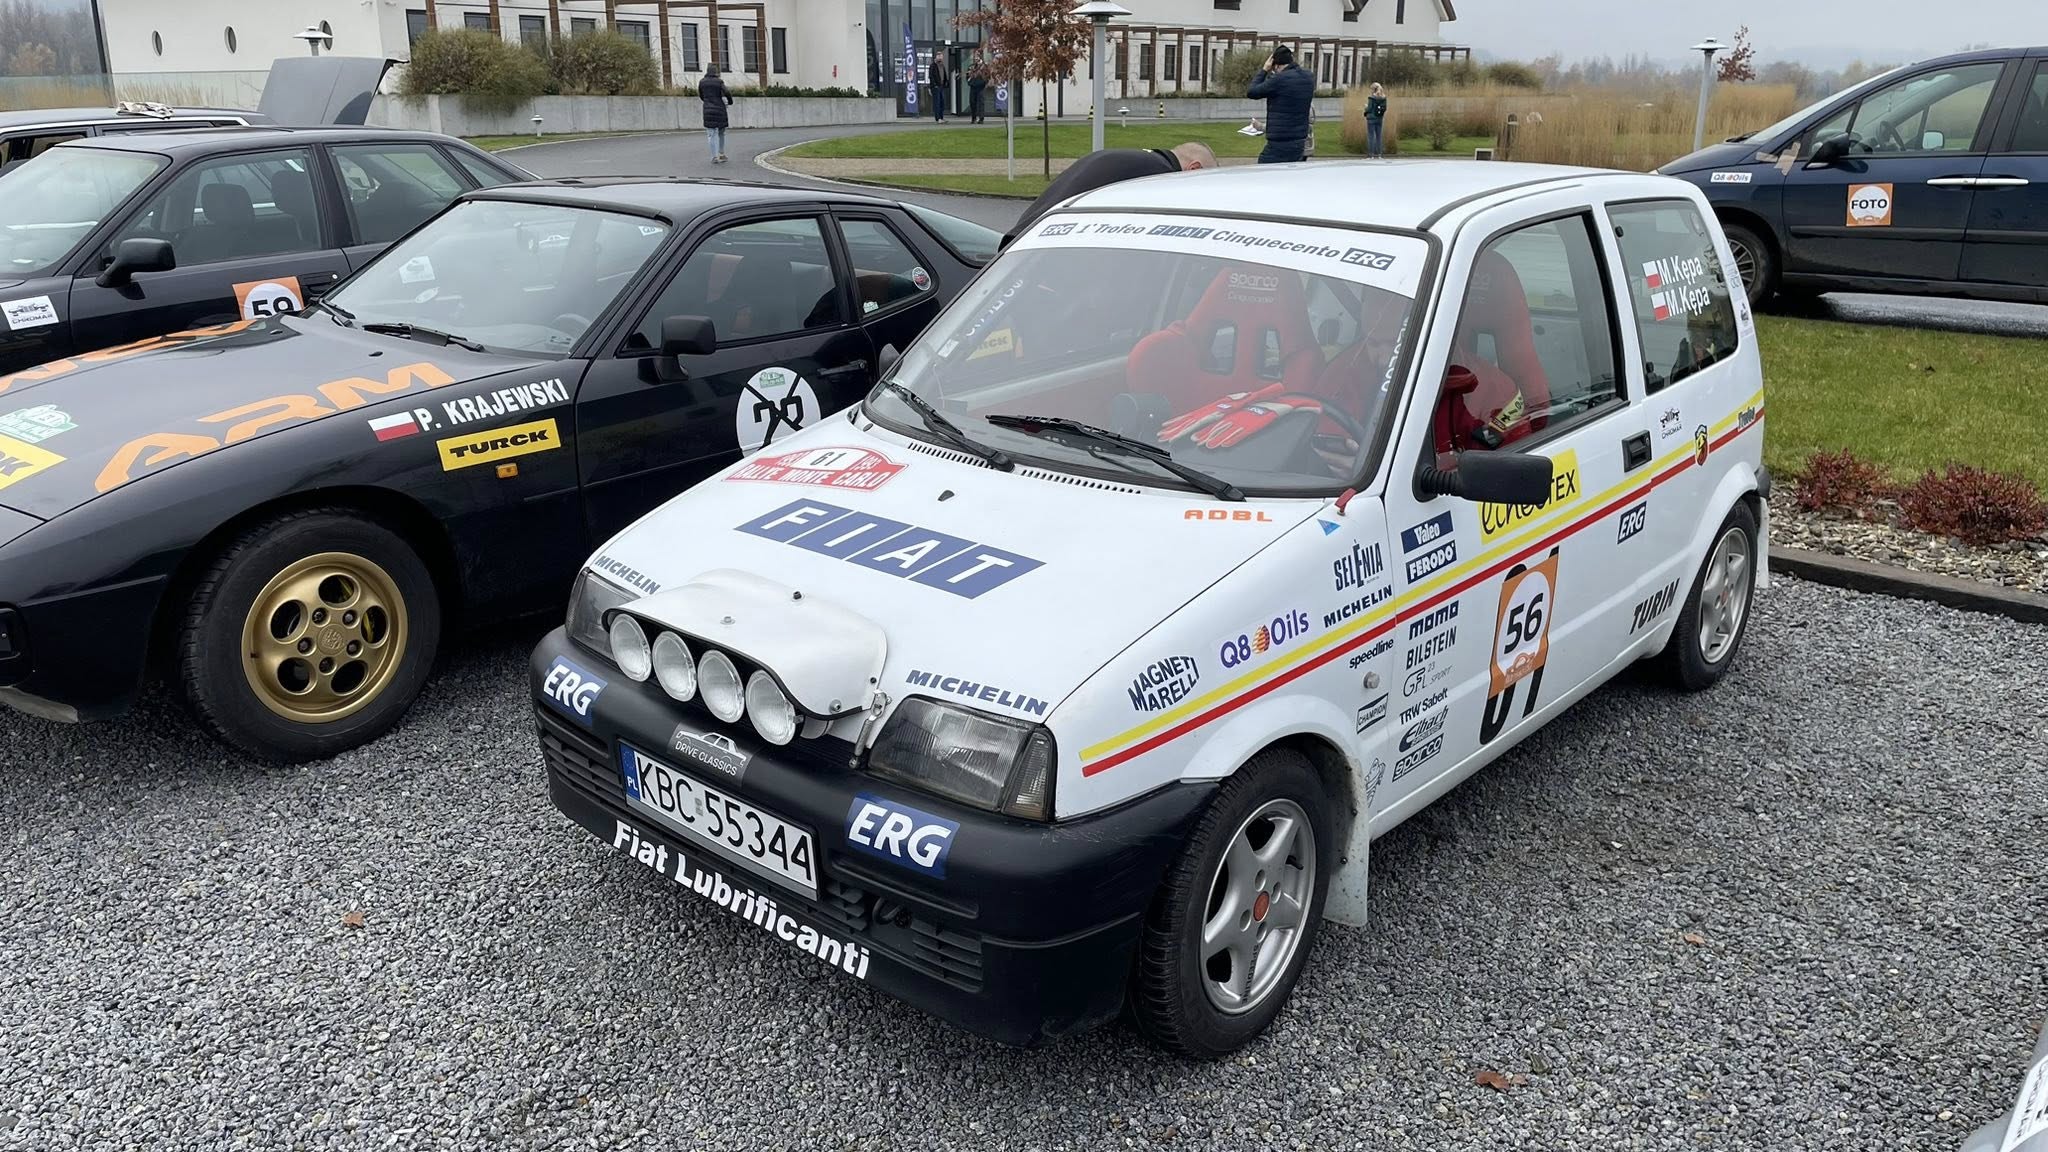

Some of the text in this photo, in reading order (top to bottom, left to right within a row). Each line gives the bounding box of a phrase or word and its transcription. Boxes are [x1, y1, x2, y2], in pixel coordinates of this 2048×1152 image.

[1851, 198, 1888, 210] FOTO
[1095, 223, 1146, 234] Trofeo
[1149, 225, 1213, 239] FIAT
[1212, 230, 1341, 259] Cinquecento
[1342, 250, 1394, 269] ERG
[1657, 255, 1704, 285] M.Kępa
[252, 297, 294, 319] 59
[1665, 286, 1711, 317] M.Kępa
[413, 378, 570, 432] P. KRAJEWSKI
[94, 361, 457, 492] ARM
[450, 429, 549, 458] TURCK
[780, 469, 836, 484] MONTE
[831, 472, 892, 488] CARLO
[810, 451, 847, 467] 61
[1184, 508, 1273, 522] ADBL
[1414, 516, 1440, 545] Valeo
[1619, 505, 1646, 541] ERG
[758, 504, 1017, 586] FIAT
[1408, 544, 1454, 581] FERODO
[593, 555, 661, 595] MICHELIN
[1323, 585, 1393, 628] MICHELIN
[1503, 592, 1544, 655] 56
[1629, 577, 1680, 635] TURIN
[1219, 609, 1310, 670] Q8 Oils
[1349, 638, 1394, 669] speedline
[1406, 626, 1457, 670] BILSTEIN
[543, 663, 601, 716] ERG
[904, 669, 1050, 716] MICHELIN
[1127, 655, 1198, 701] MAGNETI
[1132, 670, 1200, 712] MARELLI
[1358, 702, 1387, 727] CHAMPION
[1399, 688, 1449, 725] TRW Sabelt
[1399, 705, 1450, 753] Eibach
[675, 740, 738, 777] DRIVE CLASSICS
[1395, 736, 1443, 779] sparco
[626, 777, 638, 792] PL
[636, 754, 815, 882] KBC 55344
[848, 802, 952, 869] ERG
[613, 819, 871, 980] Fiat Lubrificanti
[1242, 944, 1259, 1004] SPEEDLINE
